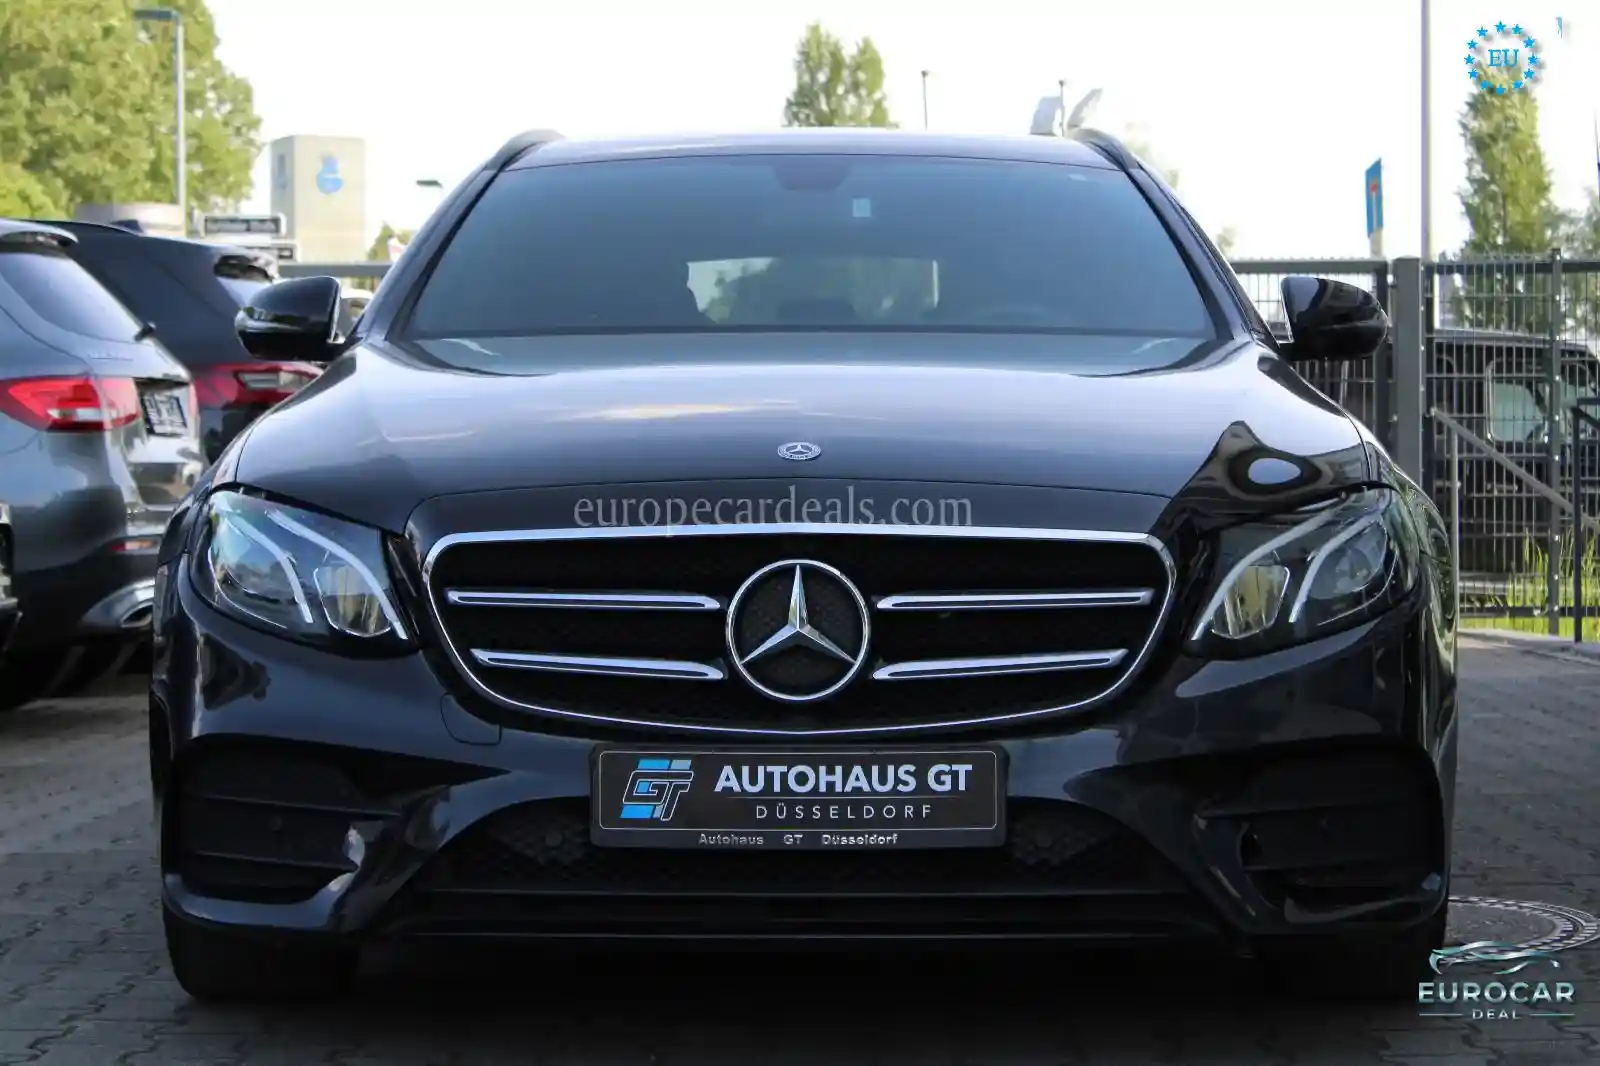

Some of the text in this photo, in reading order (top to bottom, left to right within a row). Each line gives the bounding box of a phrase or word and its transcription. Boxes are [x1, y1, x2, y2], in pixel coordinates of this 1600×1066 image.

[713, 763, 973, 793] AUTOHAUS GT
[755, 802, 932, 819] DÜSSELDORF
[699, 832, 899, 846] Autohaus GT Düsseldorf
